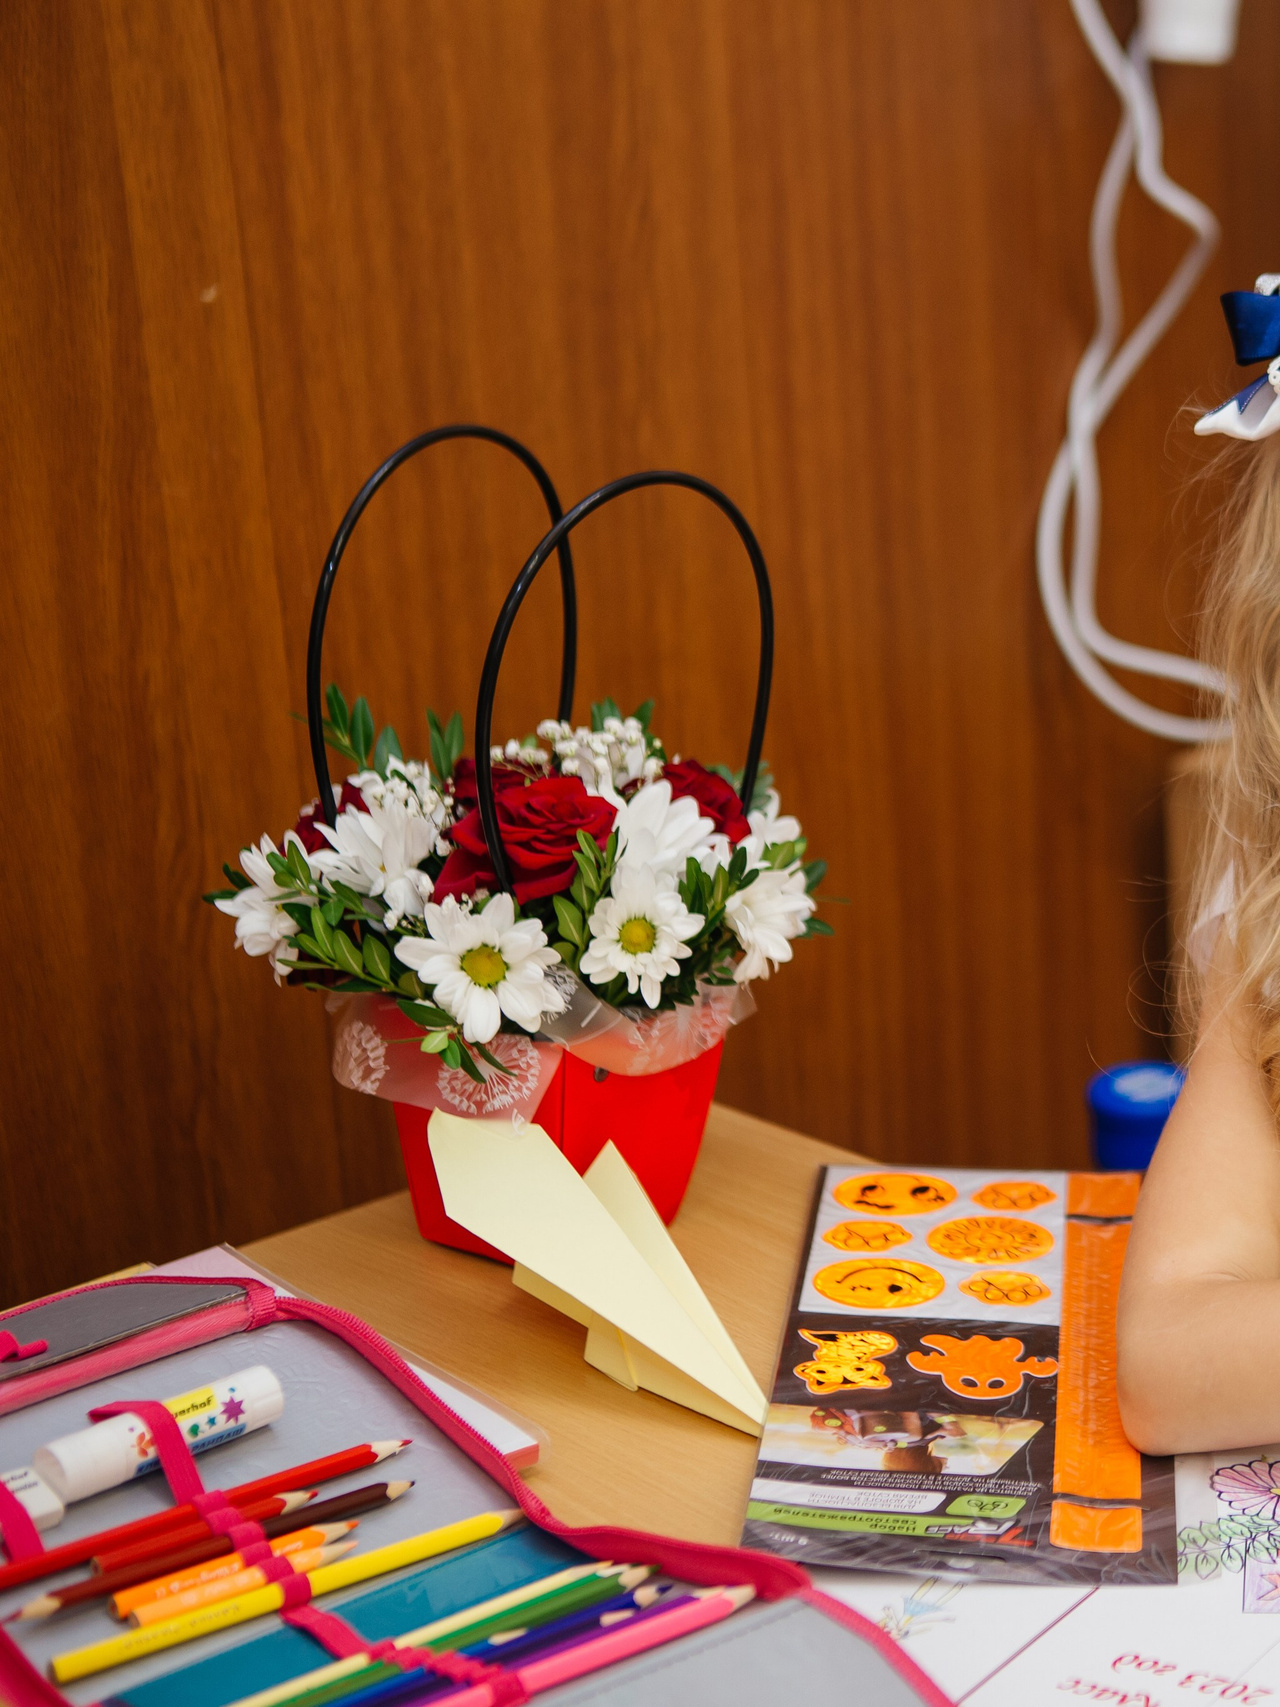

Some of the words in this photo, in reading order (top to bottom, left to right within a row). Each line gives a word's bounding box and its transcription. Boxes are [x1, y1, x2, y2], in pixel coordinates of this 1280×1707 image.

[774, 1508, 917, 1525] светоотражателей
[870, 1524, 916, 1532] Набор
[1110, 1653, 1177, 1675] год
[1176, 1672, 1274, 1706] 2023
